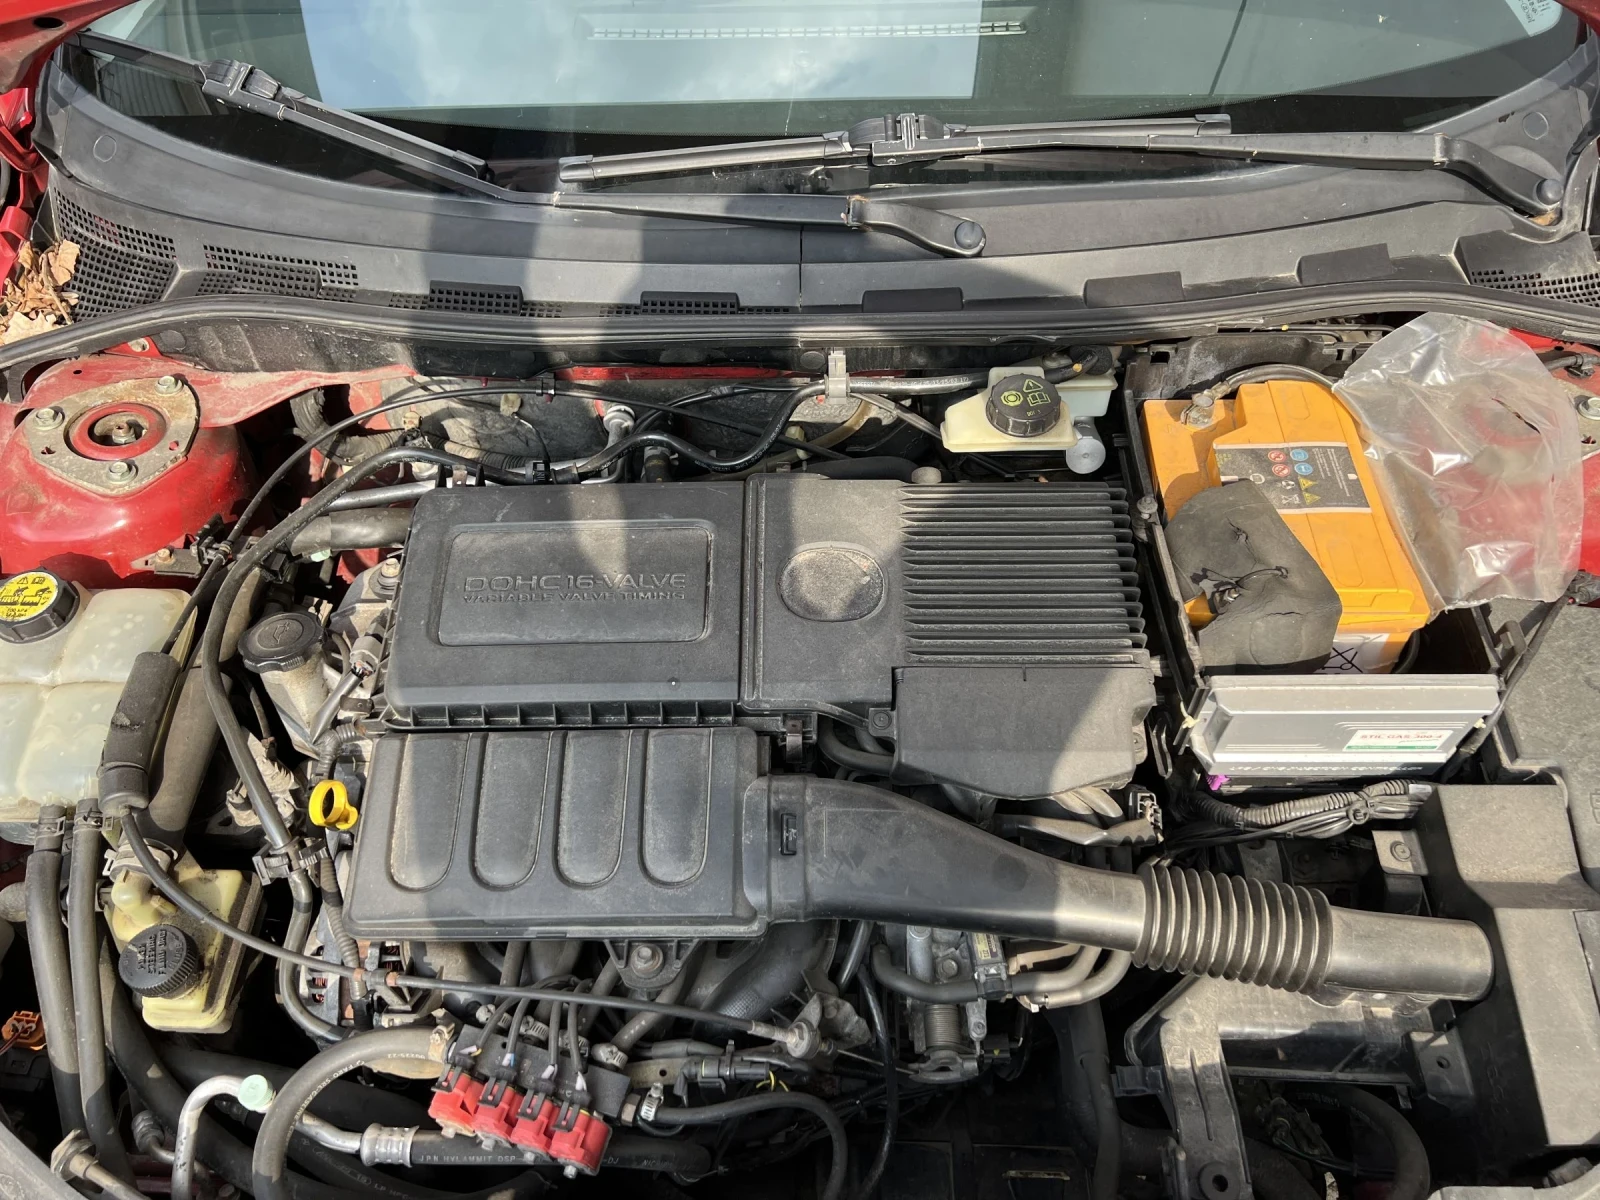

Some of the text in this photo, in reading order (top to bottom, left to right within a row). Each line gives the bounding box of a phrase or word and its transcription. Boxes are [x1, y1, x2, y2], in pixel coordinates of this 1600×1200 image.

[464, 573, 686, 592] DOHC 16-VALVE
[463, 591, 686, 604] VARIABLE VALVE TIMING
[332, 1064, 354, 1079] FARO
[420, 1155, 439, 1163] JPN
